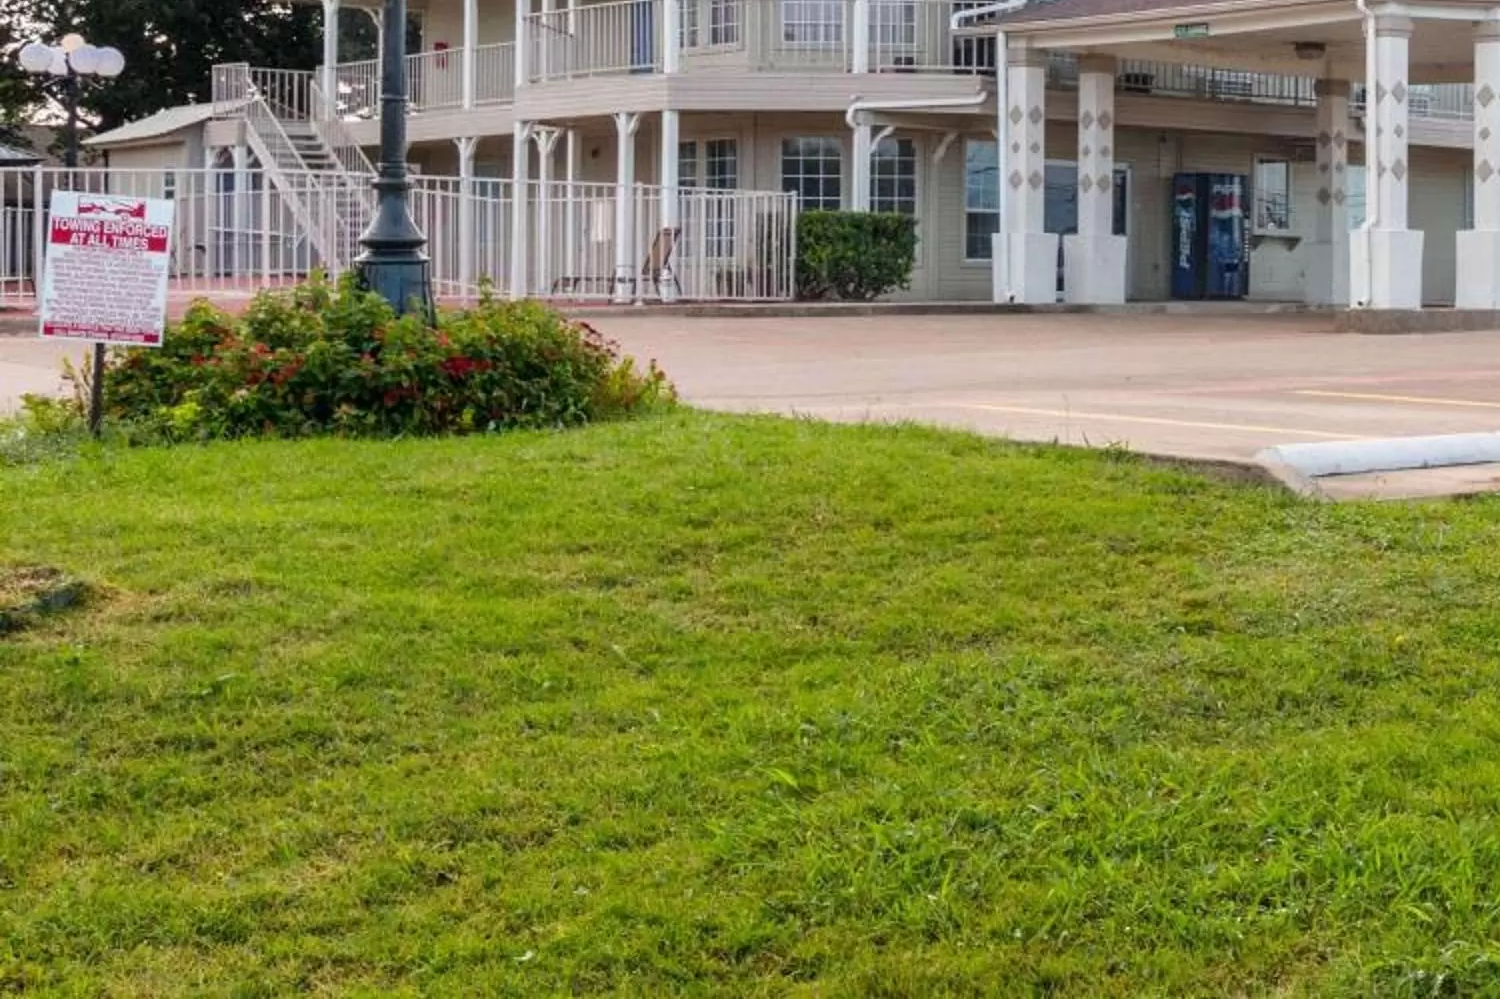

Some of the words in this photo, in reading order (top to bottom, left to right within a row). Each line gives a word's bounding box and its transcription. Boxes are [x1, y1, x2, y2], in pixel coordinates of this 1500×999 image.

[55, 218, 101, 232] TOWING
[103, 221, 167, 238] ENFORCED
[69, 232, 87, 246] AT
[87, 234, 110, 248] ALL
[111, 236, 149, 250] TIMES
